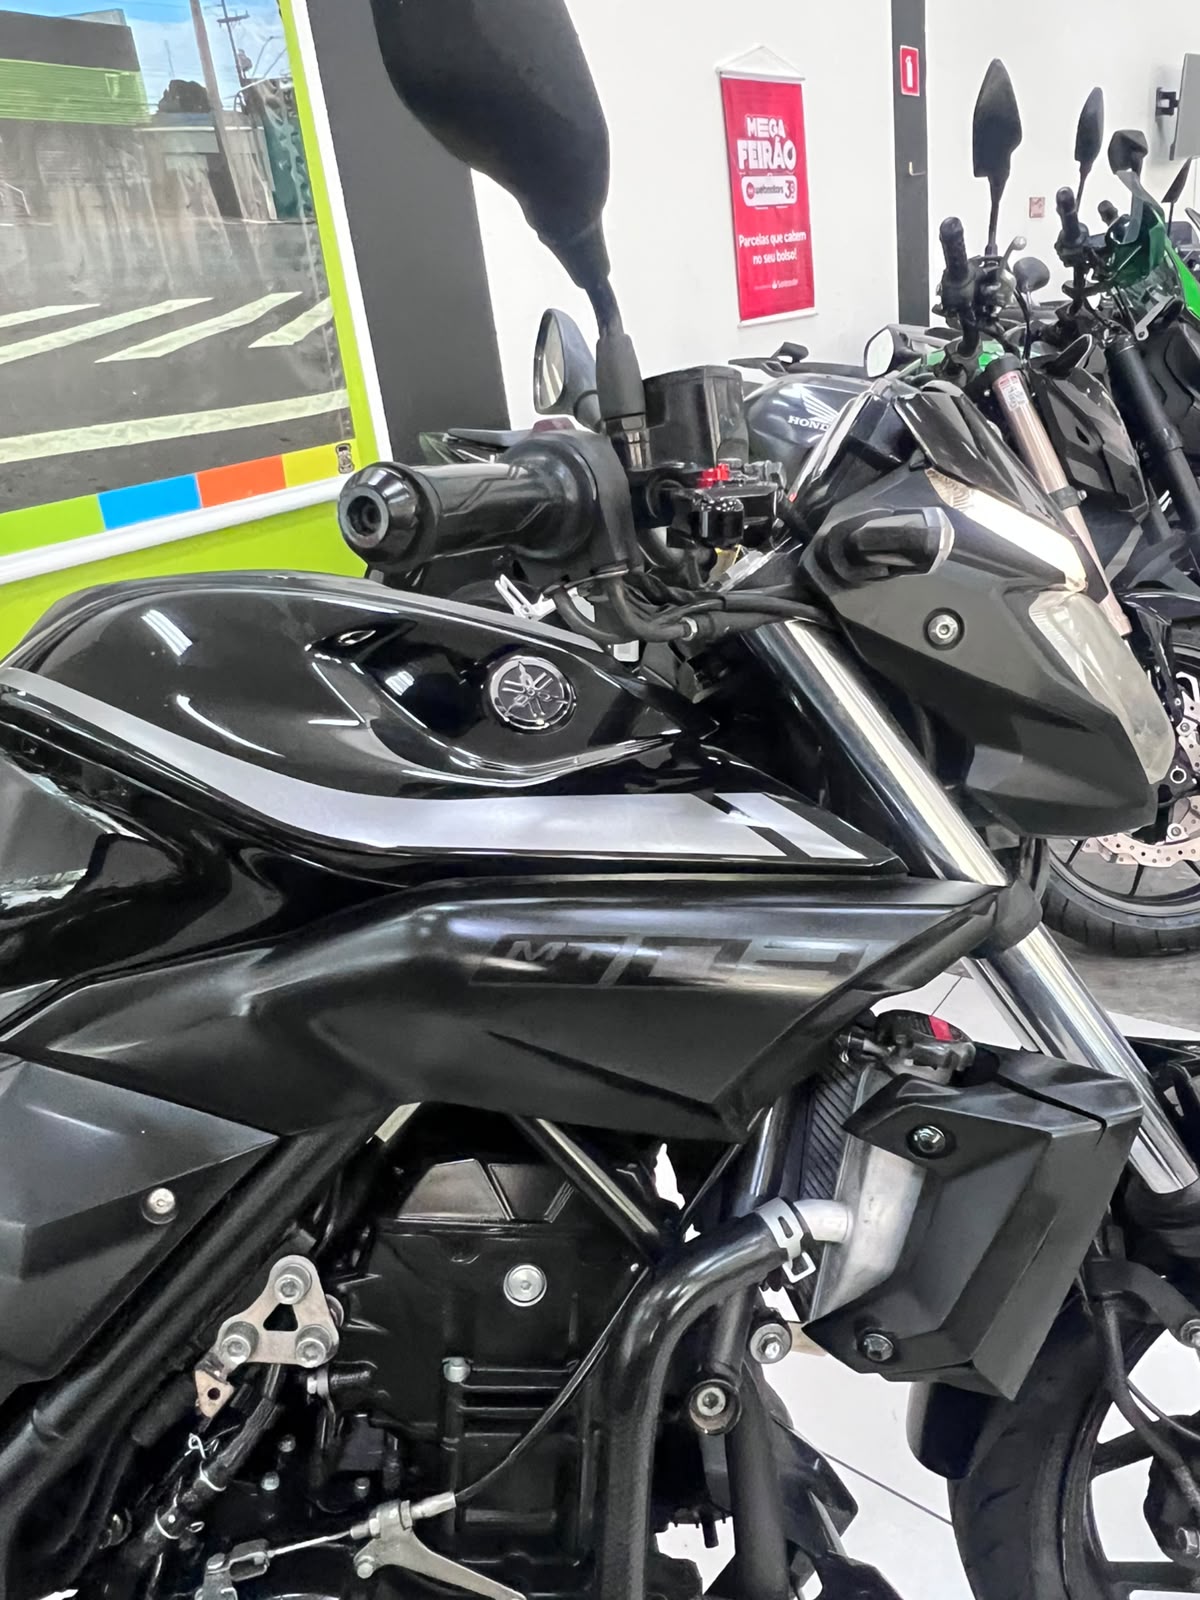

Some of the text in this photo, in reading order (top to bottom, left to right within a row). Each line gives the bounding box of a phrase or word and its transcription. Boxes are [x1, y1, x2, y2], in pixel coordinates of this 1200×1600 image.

[746, 117, 786, 138] MEGA
[737, 136, 796, 170] FEIRÃO
[738, 229, 807, 248] Parcelas que cabem
[752, 247, 797, 264] no seu bolso!
[788, 415, 830, 432] HOND
